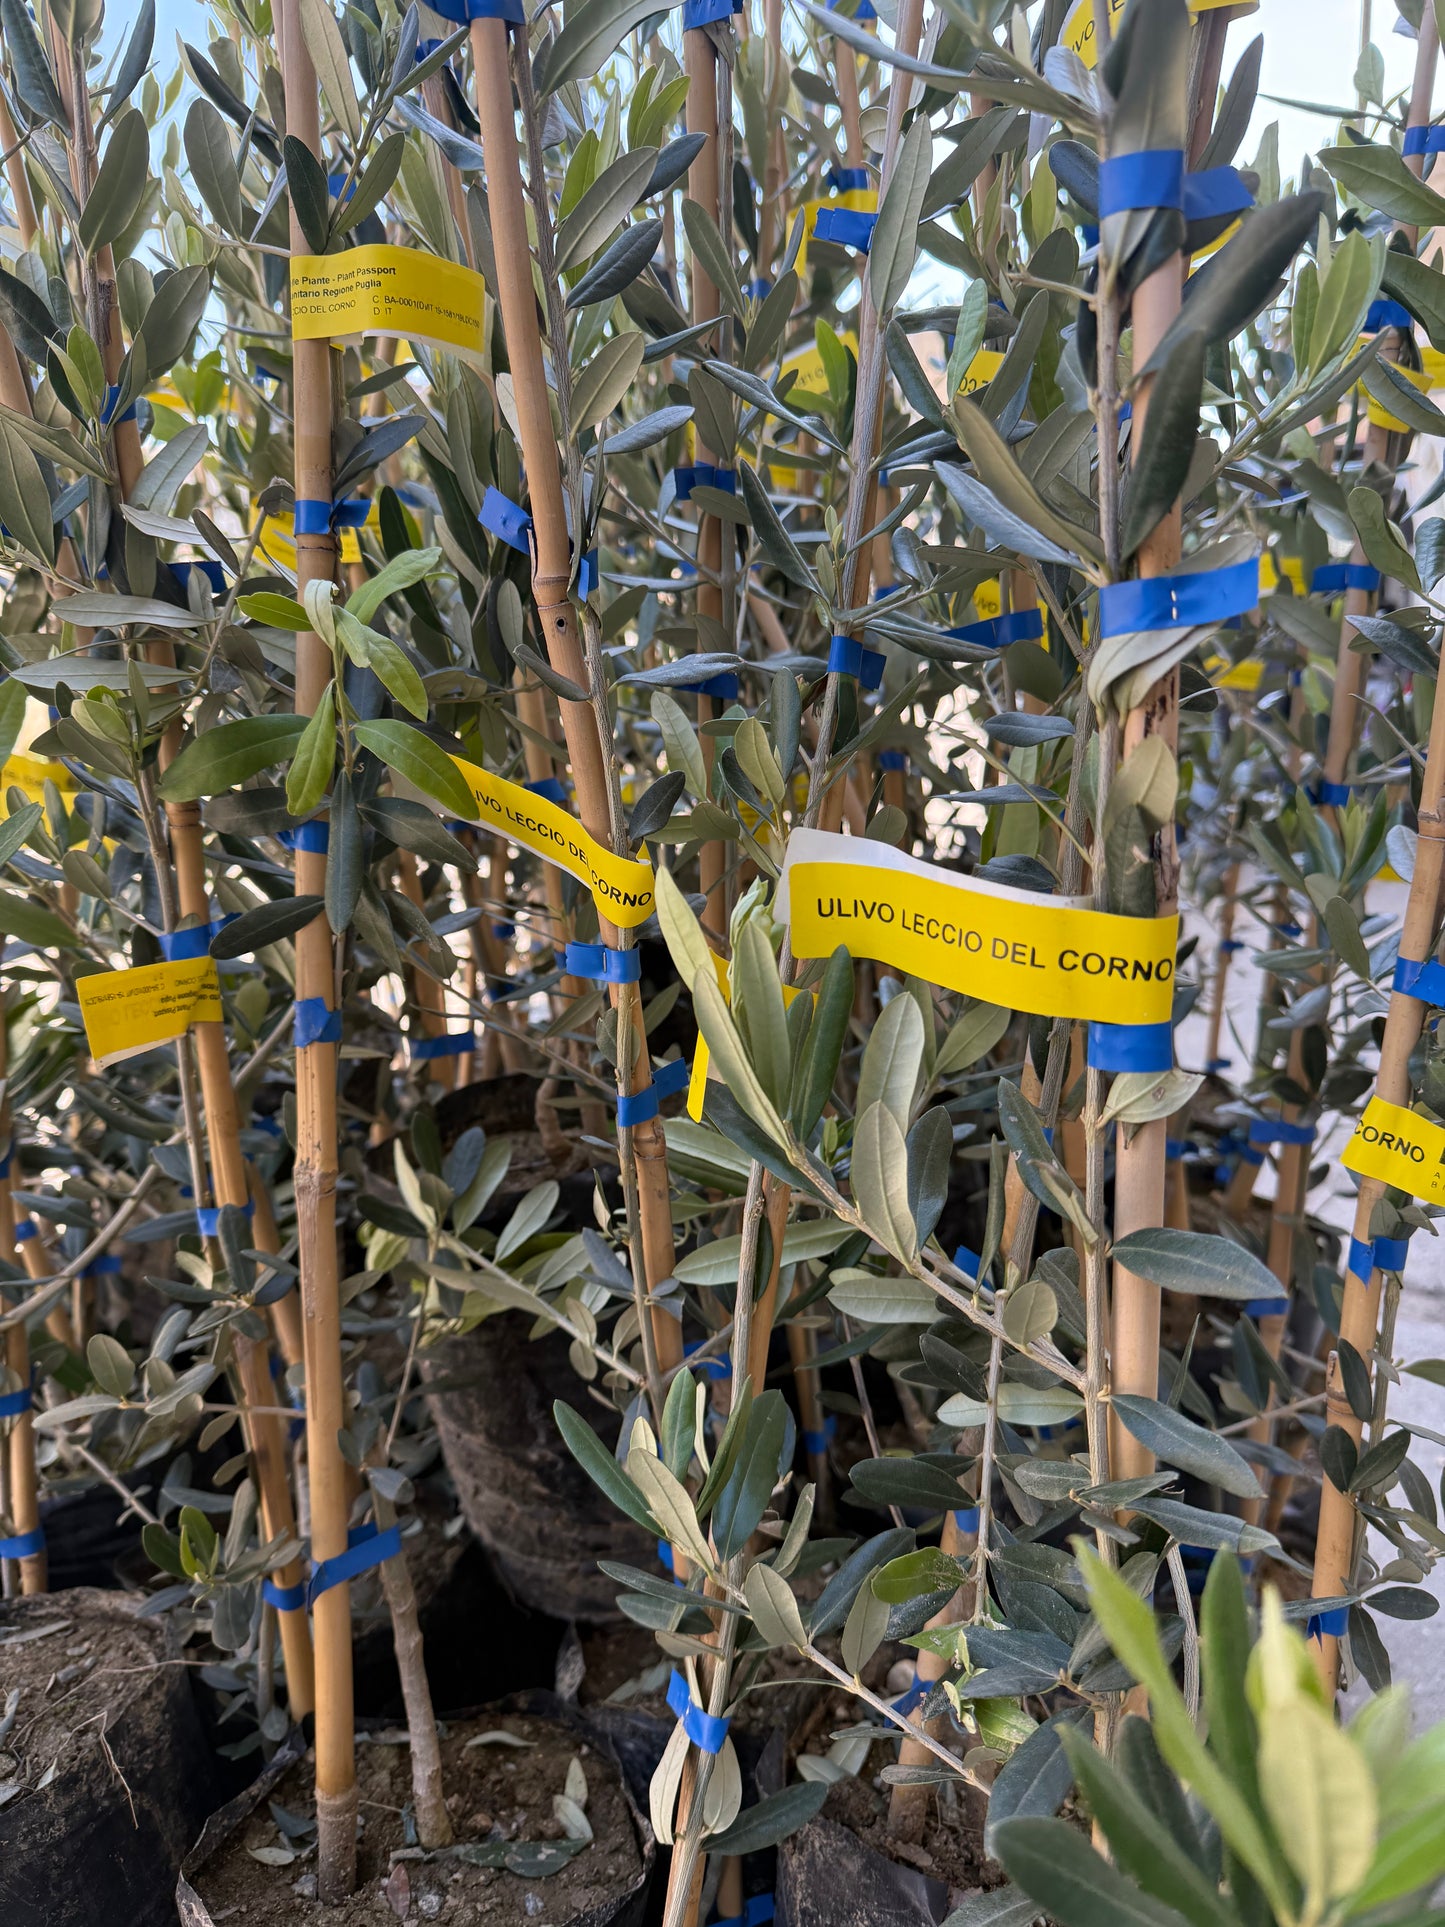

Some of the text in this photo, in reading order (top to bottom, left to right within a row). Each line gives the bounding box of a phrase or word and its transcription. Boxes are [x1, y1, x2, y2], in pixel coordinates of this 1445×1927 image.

[301, 276, 330, 285] Piante
[337, 270, 355, 282] Plant
[356, 266, 396, 277] Passport
[322, 285, 354, 298] Regione
[355, 279, 382, 291] Puglia
[309, 305, 327, 314] DEL
[328, 299, 356, 313] CORNO
[373, 307, 381, 316] D
[474, 789, 502, 814] IVO
[505, 806, 565, 847] LECCIO
[591, 869, 652, 908] CORNO
[816, 897, 1173, 982] ULIVO LECCIO DEL CORNO
